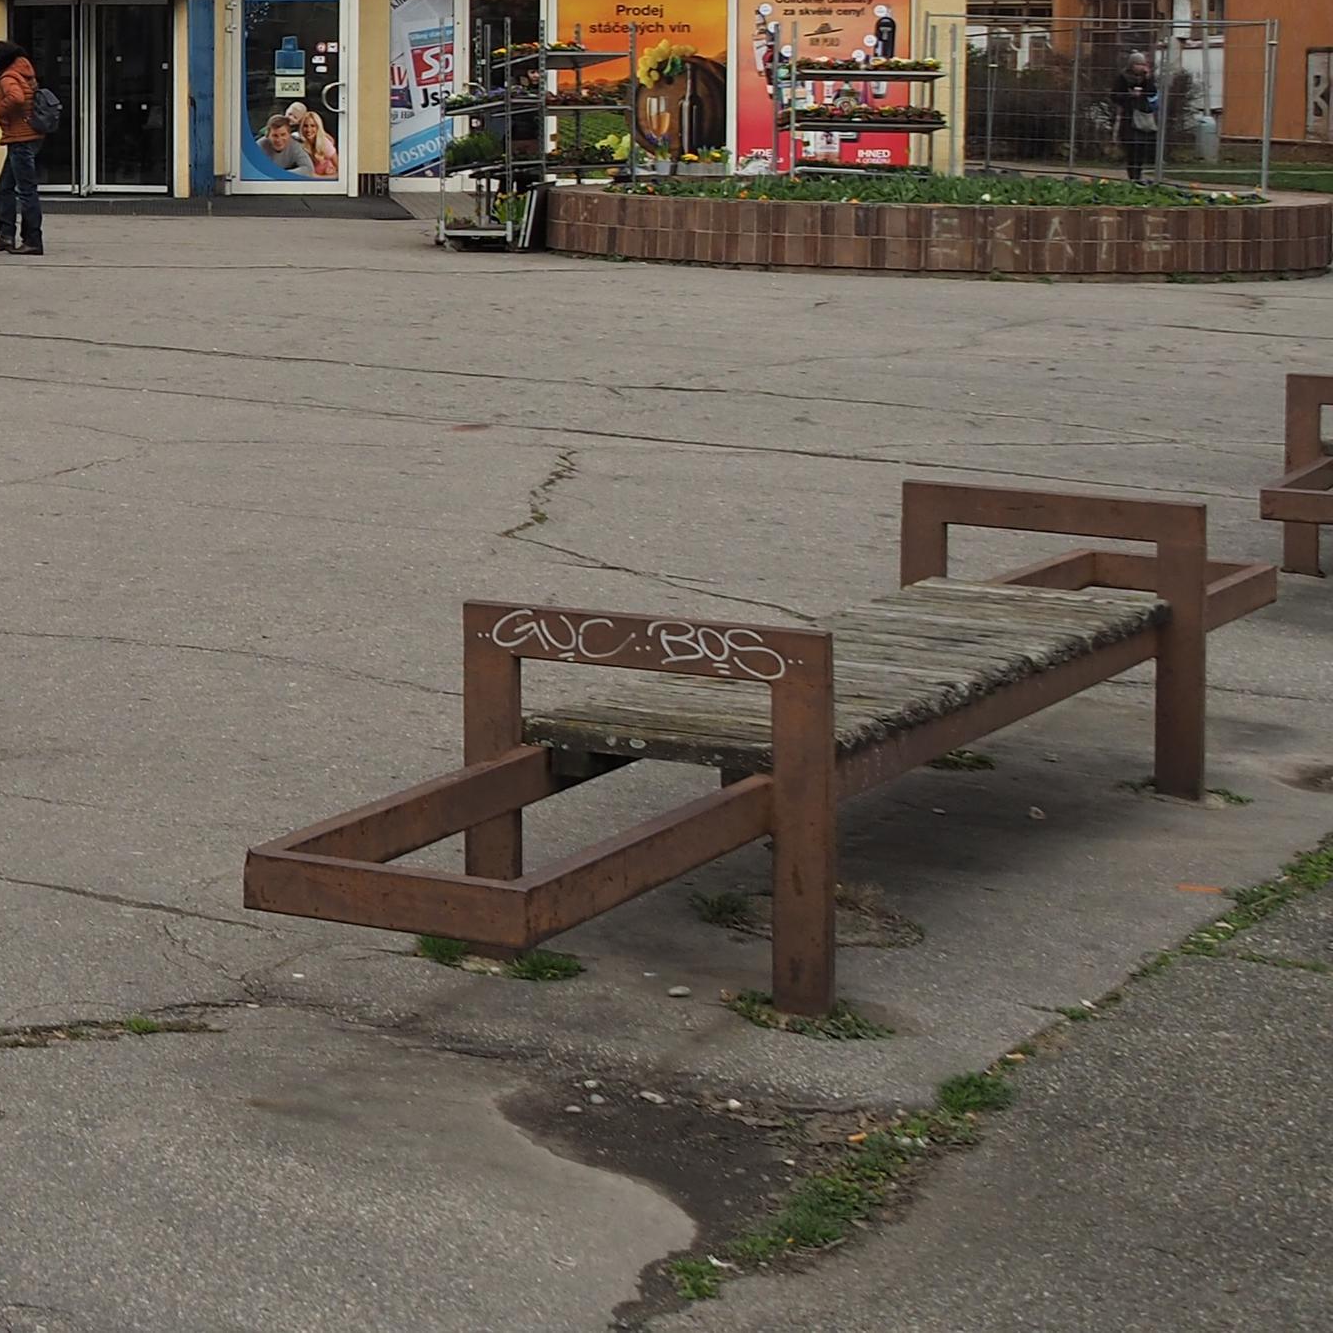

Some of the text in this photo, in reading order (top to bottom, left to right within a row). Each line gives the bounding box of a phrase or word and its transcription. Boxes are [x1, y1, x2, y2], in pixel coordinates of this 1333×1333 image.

[615, 4, 664, 18] Prodej
[669, 21, 691, 34] vín
[858, 149, 891, 158] IHNED
